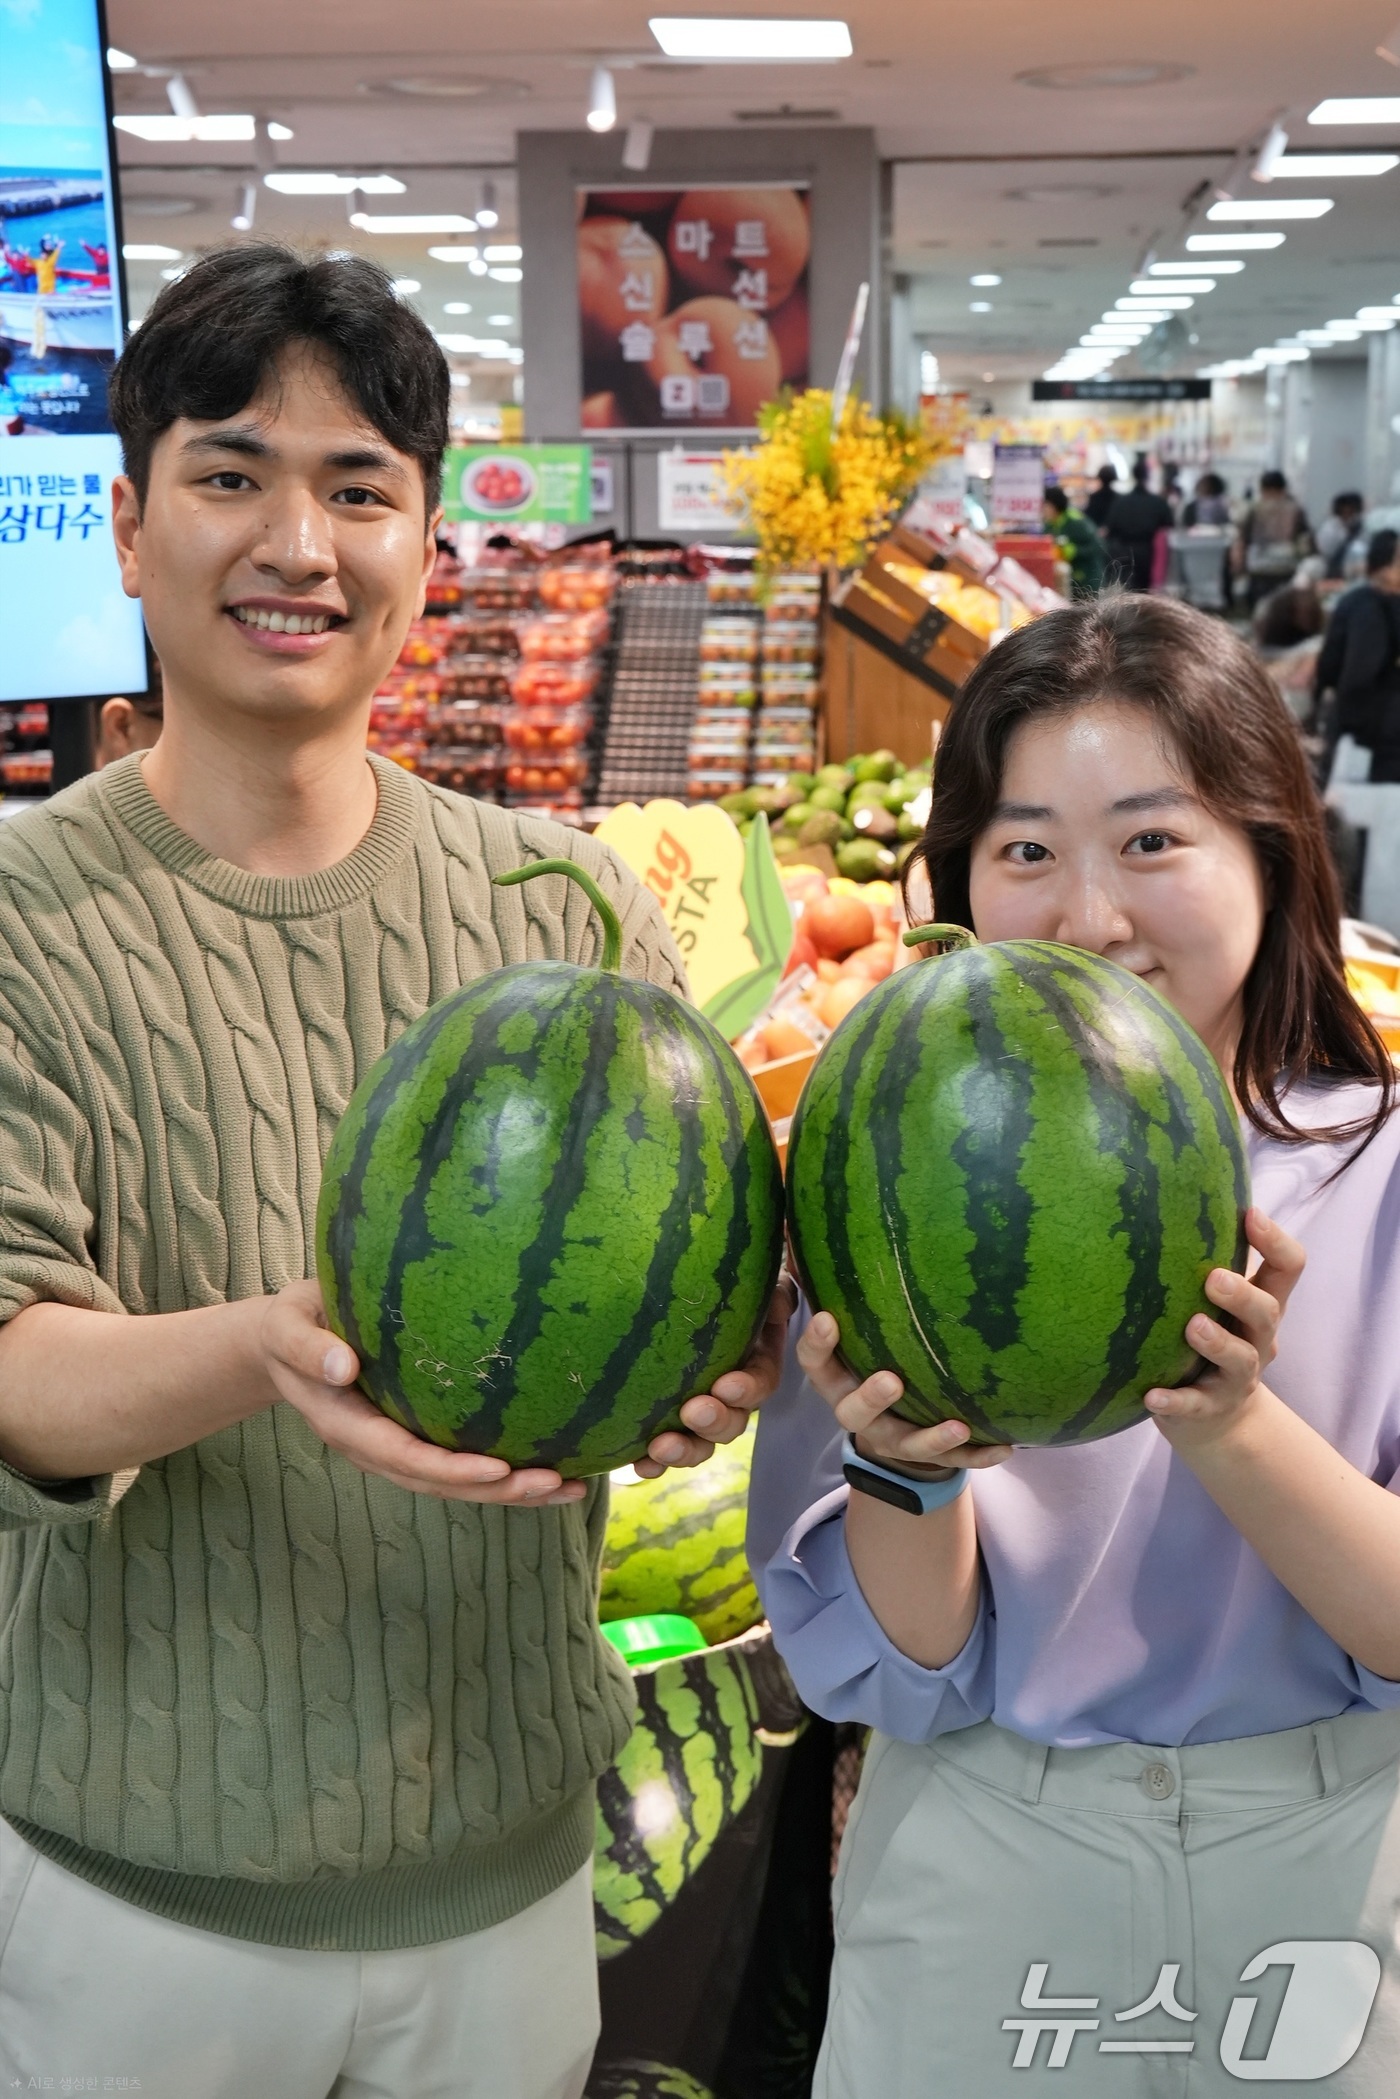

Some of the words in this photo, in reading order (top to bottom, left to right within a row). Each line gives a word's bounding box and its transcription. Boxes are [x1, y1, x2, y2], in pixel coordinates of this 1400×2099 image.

[38, 474, 77, 496] 믿는
[0, 503, 104, 543] 삼다수
[670, 877, 718, 969] STA
